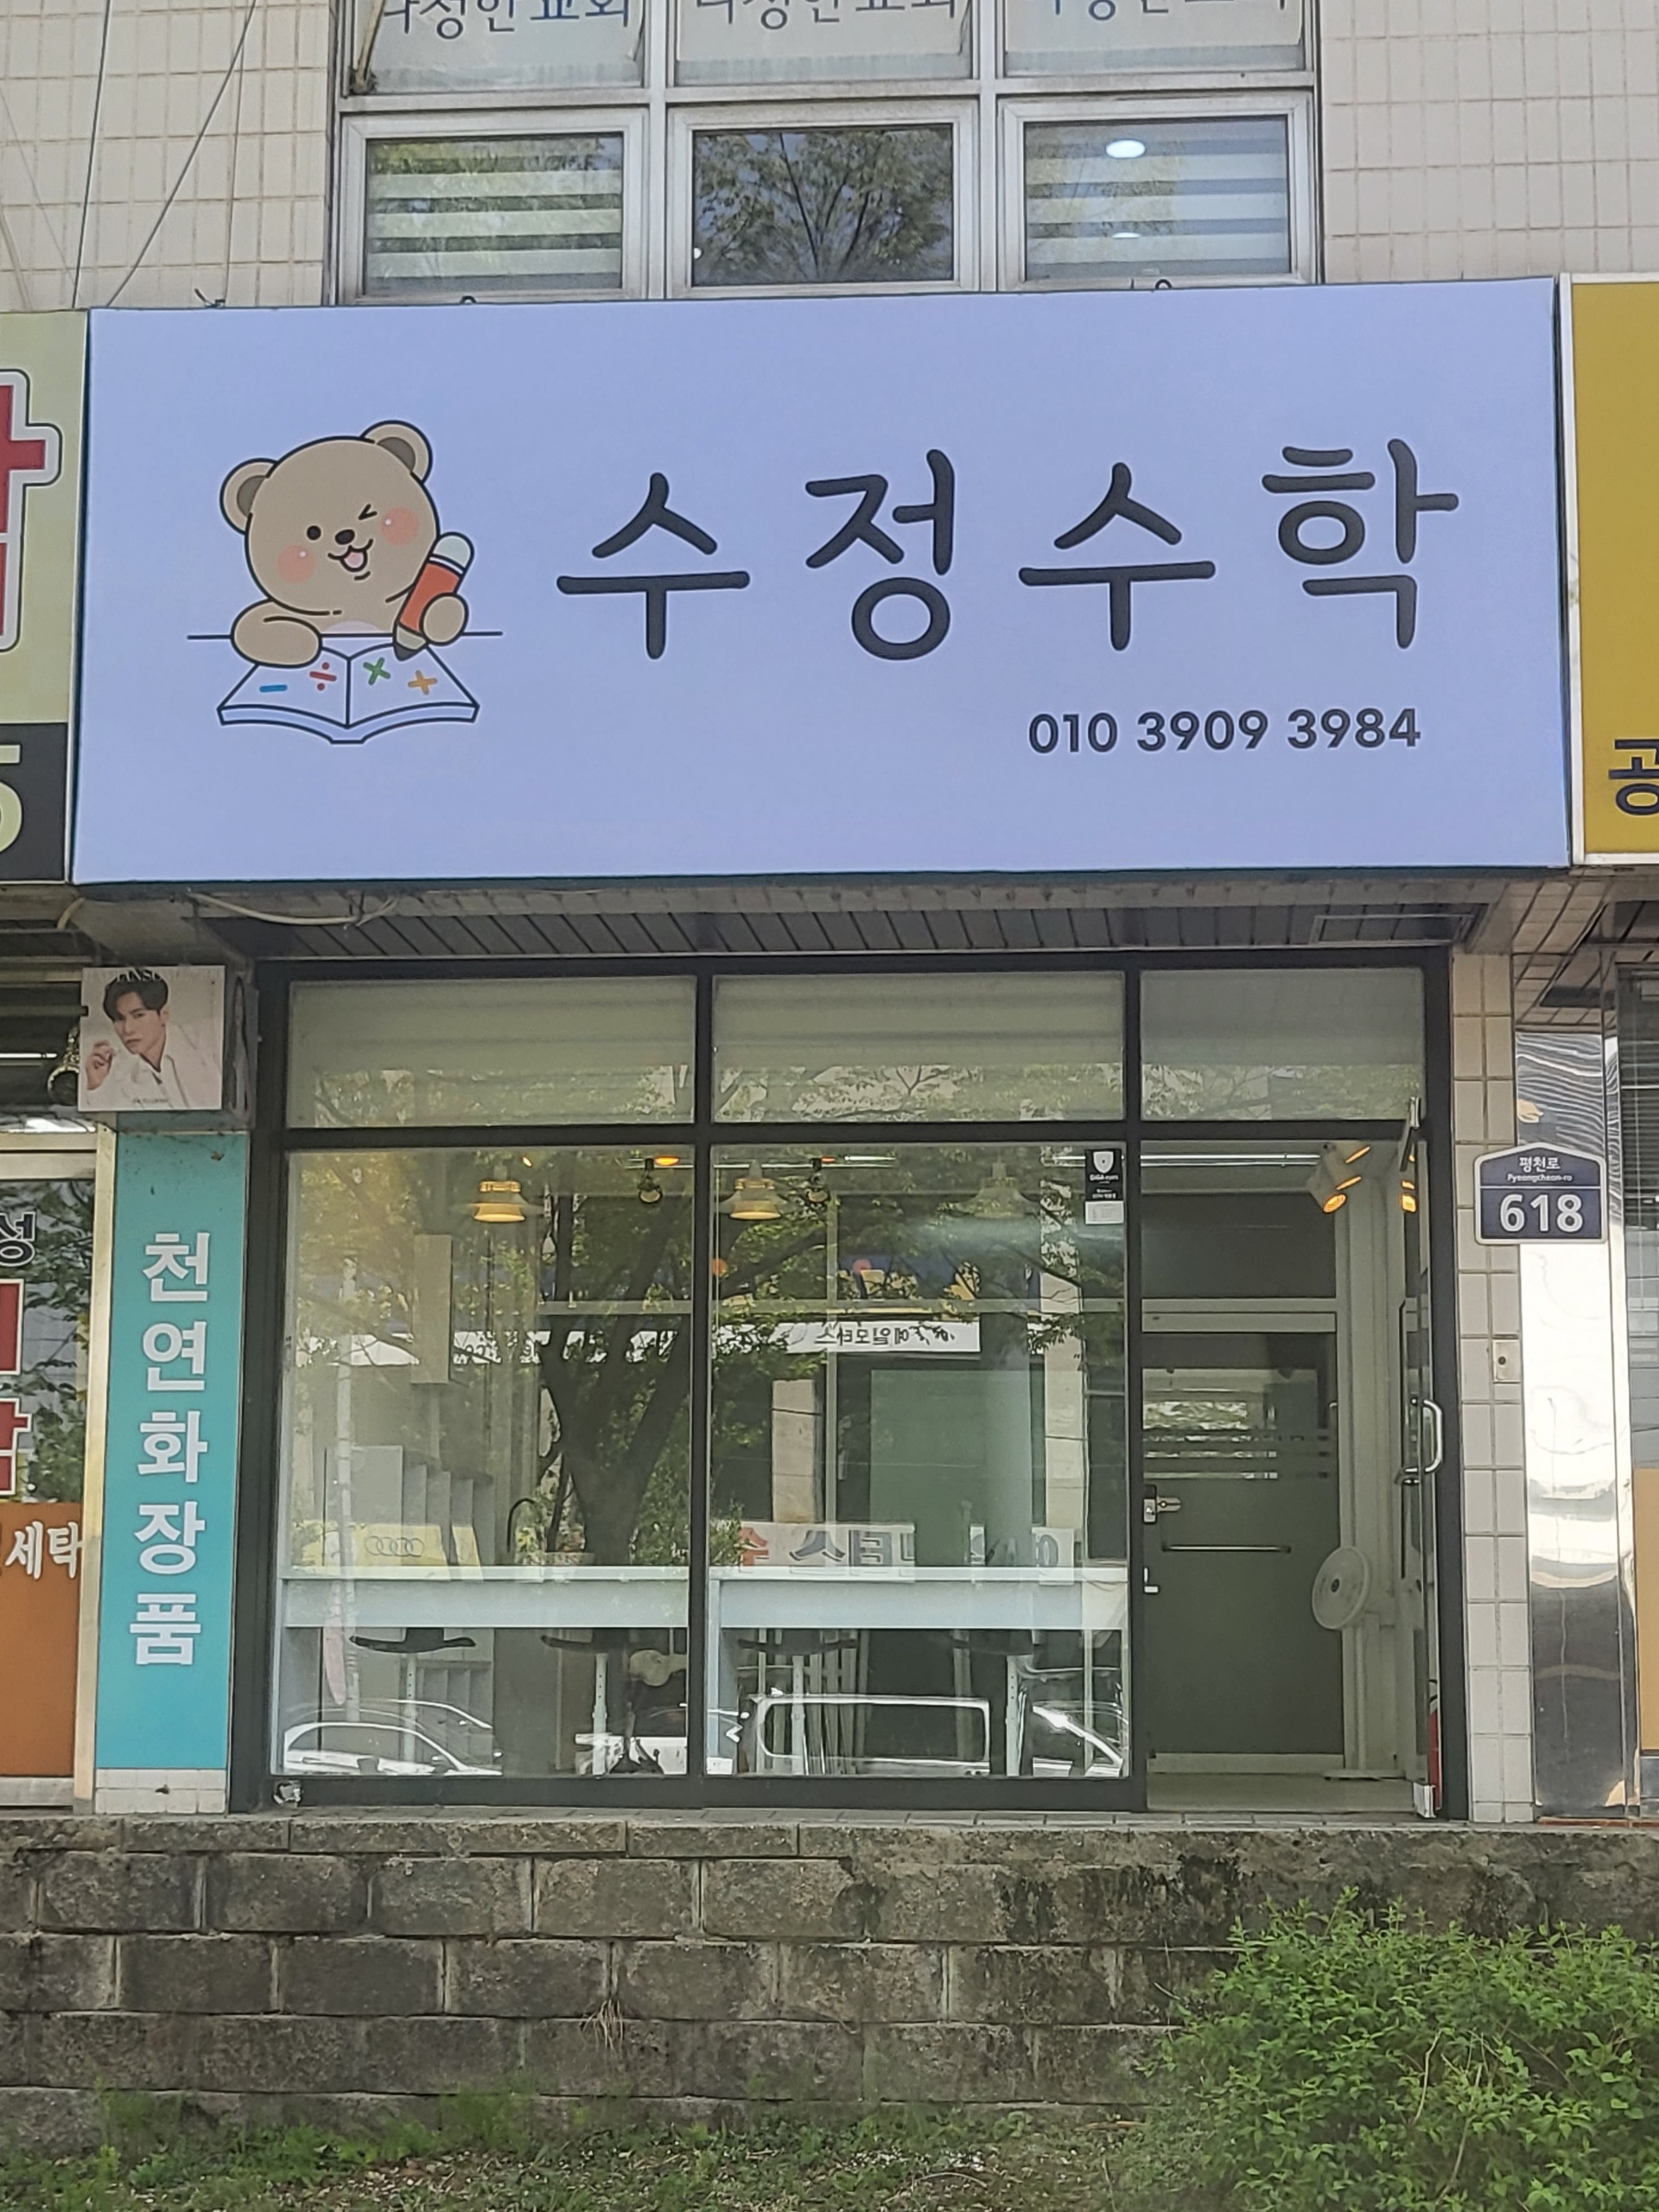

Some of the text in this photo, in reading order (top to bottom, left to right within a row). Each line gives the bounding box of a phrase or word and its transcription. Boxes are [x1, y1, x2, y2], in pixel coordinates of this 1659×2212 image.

[556, 438, 1459, 660] 수정수학
[1028, 708, 1421, 753] 010 3909 3984
[1518, 1156, 1560, 1173] 평천로
[1500, 1193, 1583, 1232] 618
[130, 1232, 210, 1666] 천연화장품
